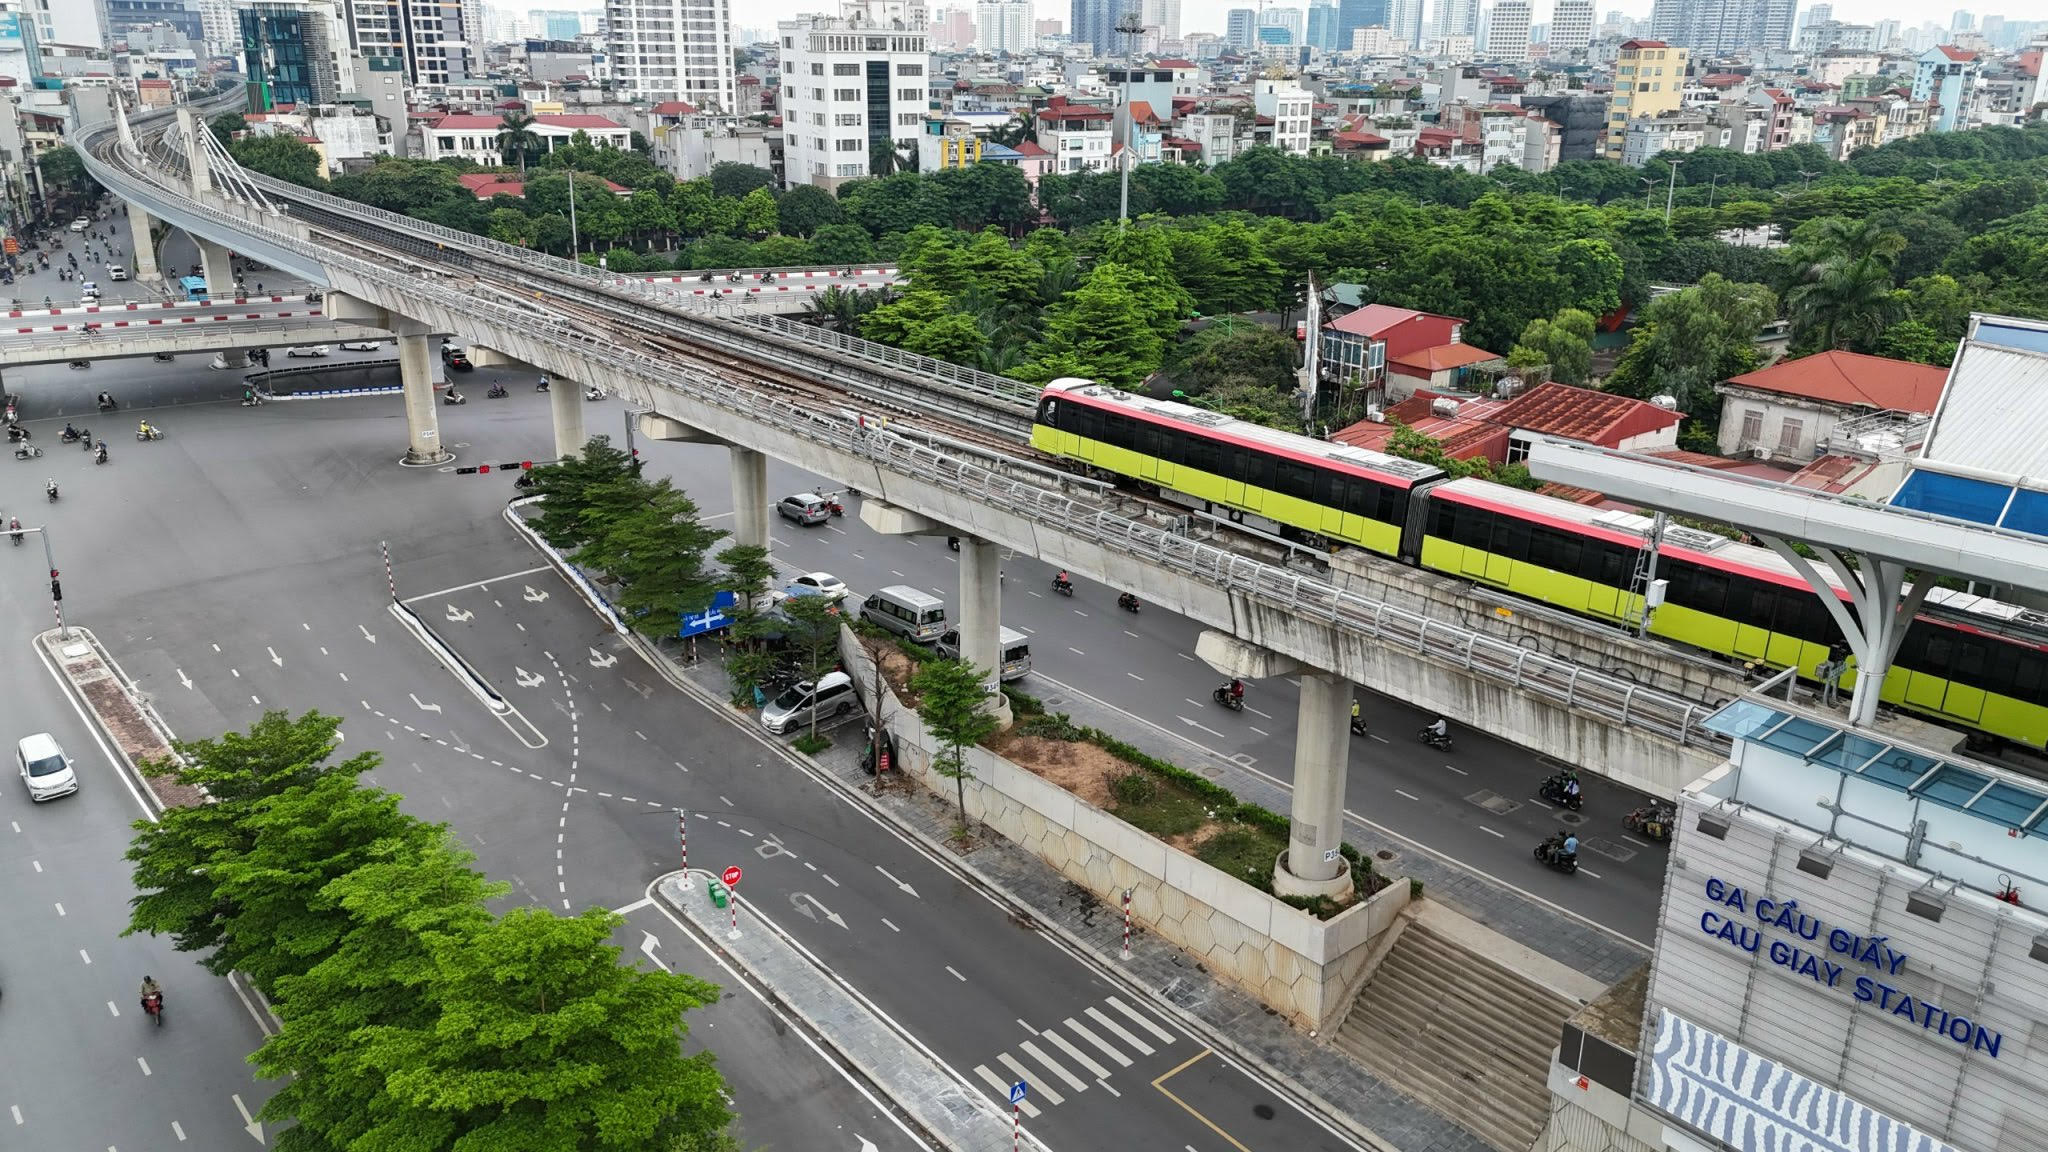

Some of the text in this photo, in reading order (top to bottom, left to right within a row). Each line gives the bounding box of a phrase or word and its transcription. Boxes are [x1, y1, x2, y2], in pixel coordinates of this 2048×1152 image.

[725, 871, 739, 880] STOP
[1706, 877, 1908, 976] GA CẦU GIẤY
[1701, 910, 2002, 1059] CAU GIAY STATION
